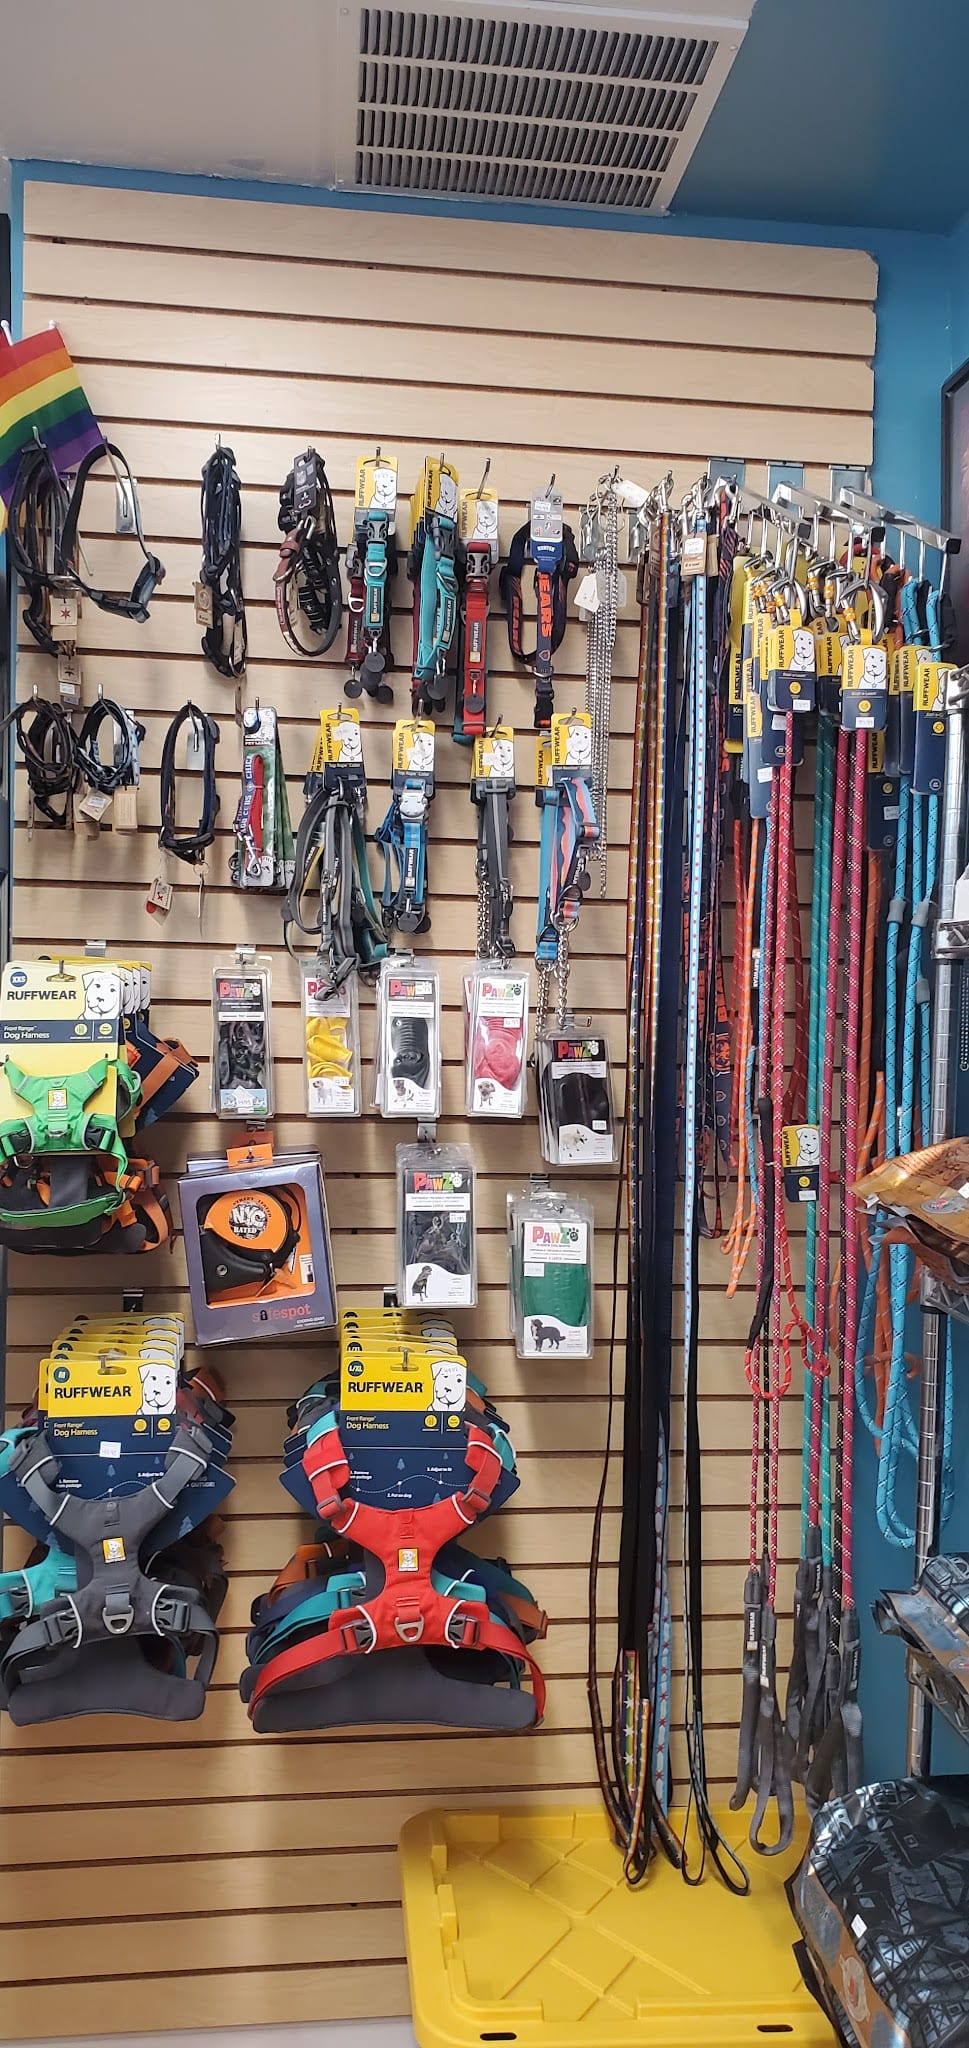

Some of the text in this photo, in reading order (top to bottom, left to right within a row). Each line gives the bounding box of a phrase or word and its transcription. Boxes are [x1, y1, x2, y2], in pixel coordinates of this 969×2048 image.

[12, 975, 26, 983] XXS
[7, 991, 77, 1000] RUFFWEAR
[482, 983, 514, 998] PAWZ
[4, 1032, 50, 1040] Dog Harness
[558, 1041, 592, 1058] PAWZ
[784, 1131, 792, 1166] RUFFWEAR
[414, 1172, 454, 1193] PAWZ
[232, 1204, 267, 1228] NYC
[233, 1226, 258, 1234] RATED
[532, 1226, 570, 1244] PAWZ
[54, 1386, 131, 1399] RUFFWEAR
[348, 1382, 423, 1393] RUFFWEAR
[346, 1422, 361, 1430] Dog
[54, 1428, 98, 1438] Dog Harness
